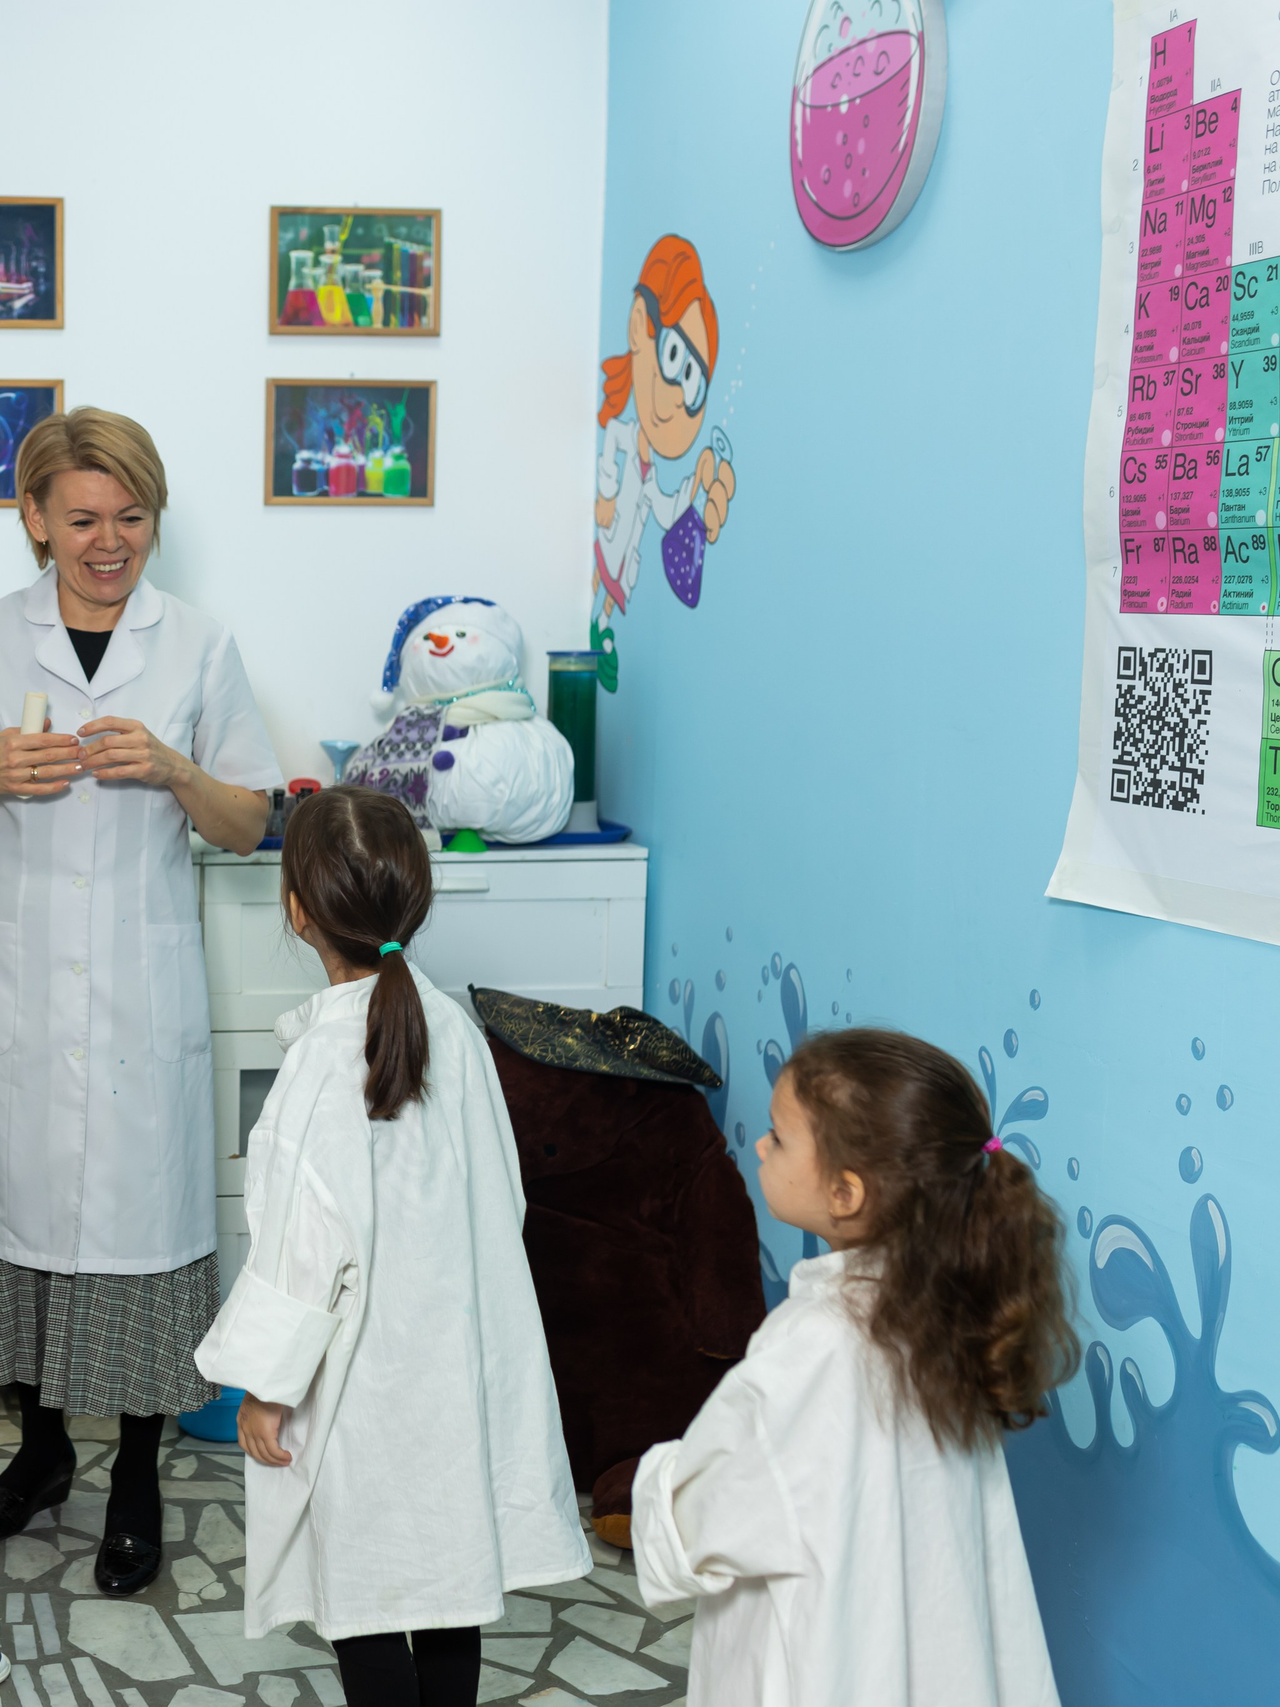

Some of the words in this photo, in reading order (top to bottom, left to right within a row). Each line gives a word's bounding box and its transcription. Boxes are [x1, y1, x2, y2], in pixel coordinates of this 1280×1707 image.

[1187, 27, 1192, 42] 1
[1154, 38, 1167, 69] H
[1211, 78, 1221, 92] IIA
[1231, 97, 1238, 113] 4
[1184, 114, 1190, 130] 3
[1195, 109, 1219, 139] Be
[1149, 123, 1165, 154] Li
[1133, 158, 1139, 171] 2
[1222, 186, 1232, 204] 12
[1175, 200, 1184, 216] 11
[1189, 194, 1216, 229] Mg
[1143, 207, 1168, 237] Na
[1129, 242, 1134, 254] 3
[1249, 241, 1264, 256] IIIB
[1267, 264, 1279, 282] 21
[1215, 275, 1229, 292] 20
[1233, 271, 1258, 301] Sc
[1169, 285, 1180, 301] 19
[1184, 281, 1210, 311] Ca
[1138, 291, 1151, 320] K
[1124, 324, 1129, 335] 4
[1231, 325, 1260, 338] Скандий
[1230, 336, 1260, 349] Scandium
[1212, 362, 1226, 380] 38
[1262, 355, 1277, 372] 39
[1163, 370, 1176, 387] 37
[1231, 359, 1244, 389] Y
[1132, 374, 1157, 402] Rb
[1180, 368, 1202, 397] Sr
[1270, 397, 1277, 406] +3
[1117, 406, 1123, 417] 5
[1228, 411, 1253, 425] Иттрий
[1175, 419, 1209, 431] Стронций
[1155, 454, 1168, 470] 55
[1206, 450, 1220, 466] 56
[1255, 446, 1270, 462] 57
[1123, 456, 1147, 484] Cs
[1172, 453, 1198, 481] Ba
[1225, 449, 1250, 477] La
[1109, 486, 1115, 498] 6
[1209, 490, 1217, 499] +2
[1258, 487, 1267, 496] +3
[1170, 504, 1190, 515] Барий
[1221, 503, 1246, 513] Лантан
[1221, 514, 1256, 524] Lanthanum
[1153, 538, 1166, 553] 87
[1203, 536, 1217, 551] 88
[1224, 535, 1250, 564] Ac
[1252, 534, 1266, 550] 89
[1124, 538, 1142, 564] Fr
[1172, 537, 1199, 564] Ra
[1112, 567, 1117, 578] 7
[1211, 575, 1219, 584] +2
[1260, 575, 1269, 584] +3
[1123, 589, 1150, 598] Франций
[1171, 588, 1192, 599] Радий
[1223, 589, 1254, 599] Актиний
[1170, 600, 1193, 609] Radium
[1222, 600, 1250, 610] Actinium
